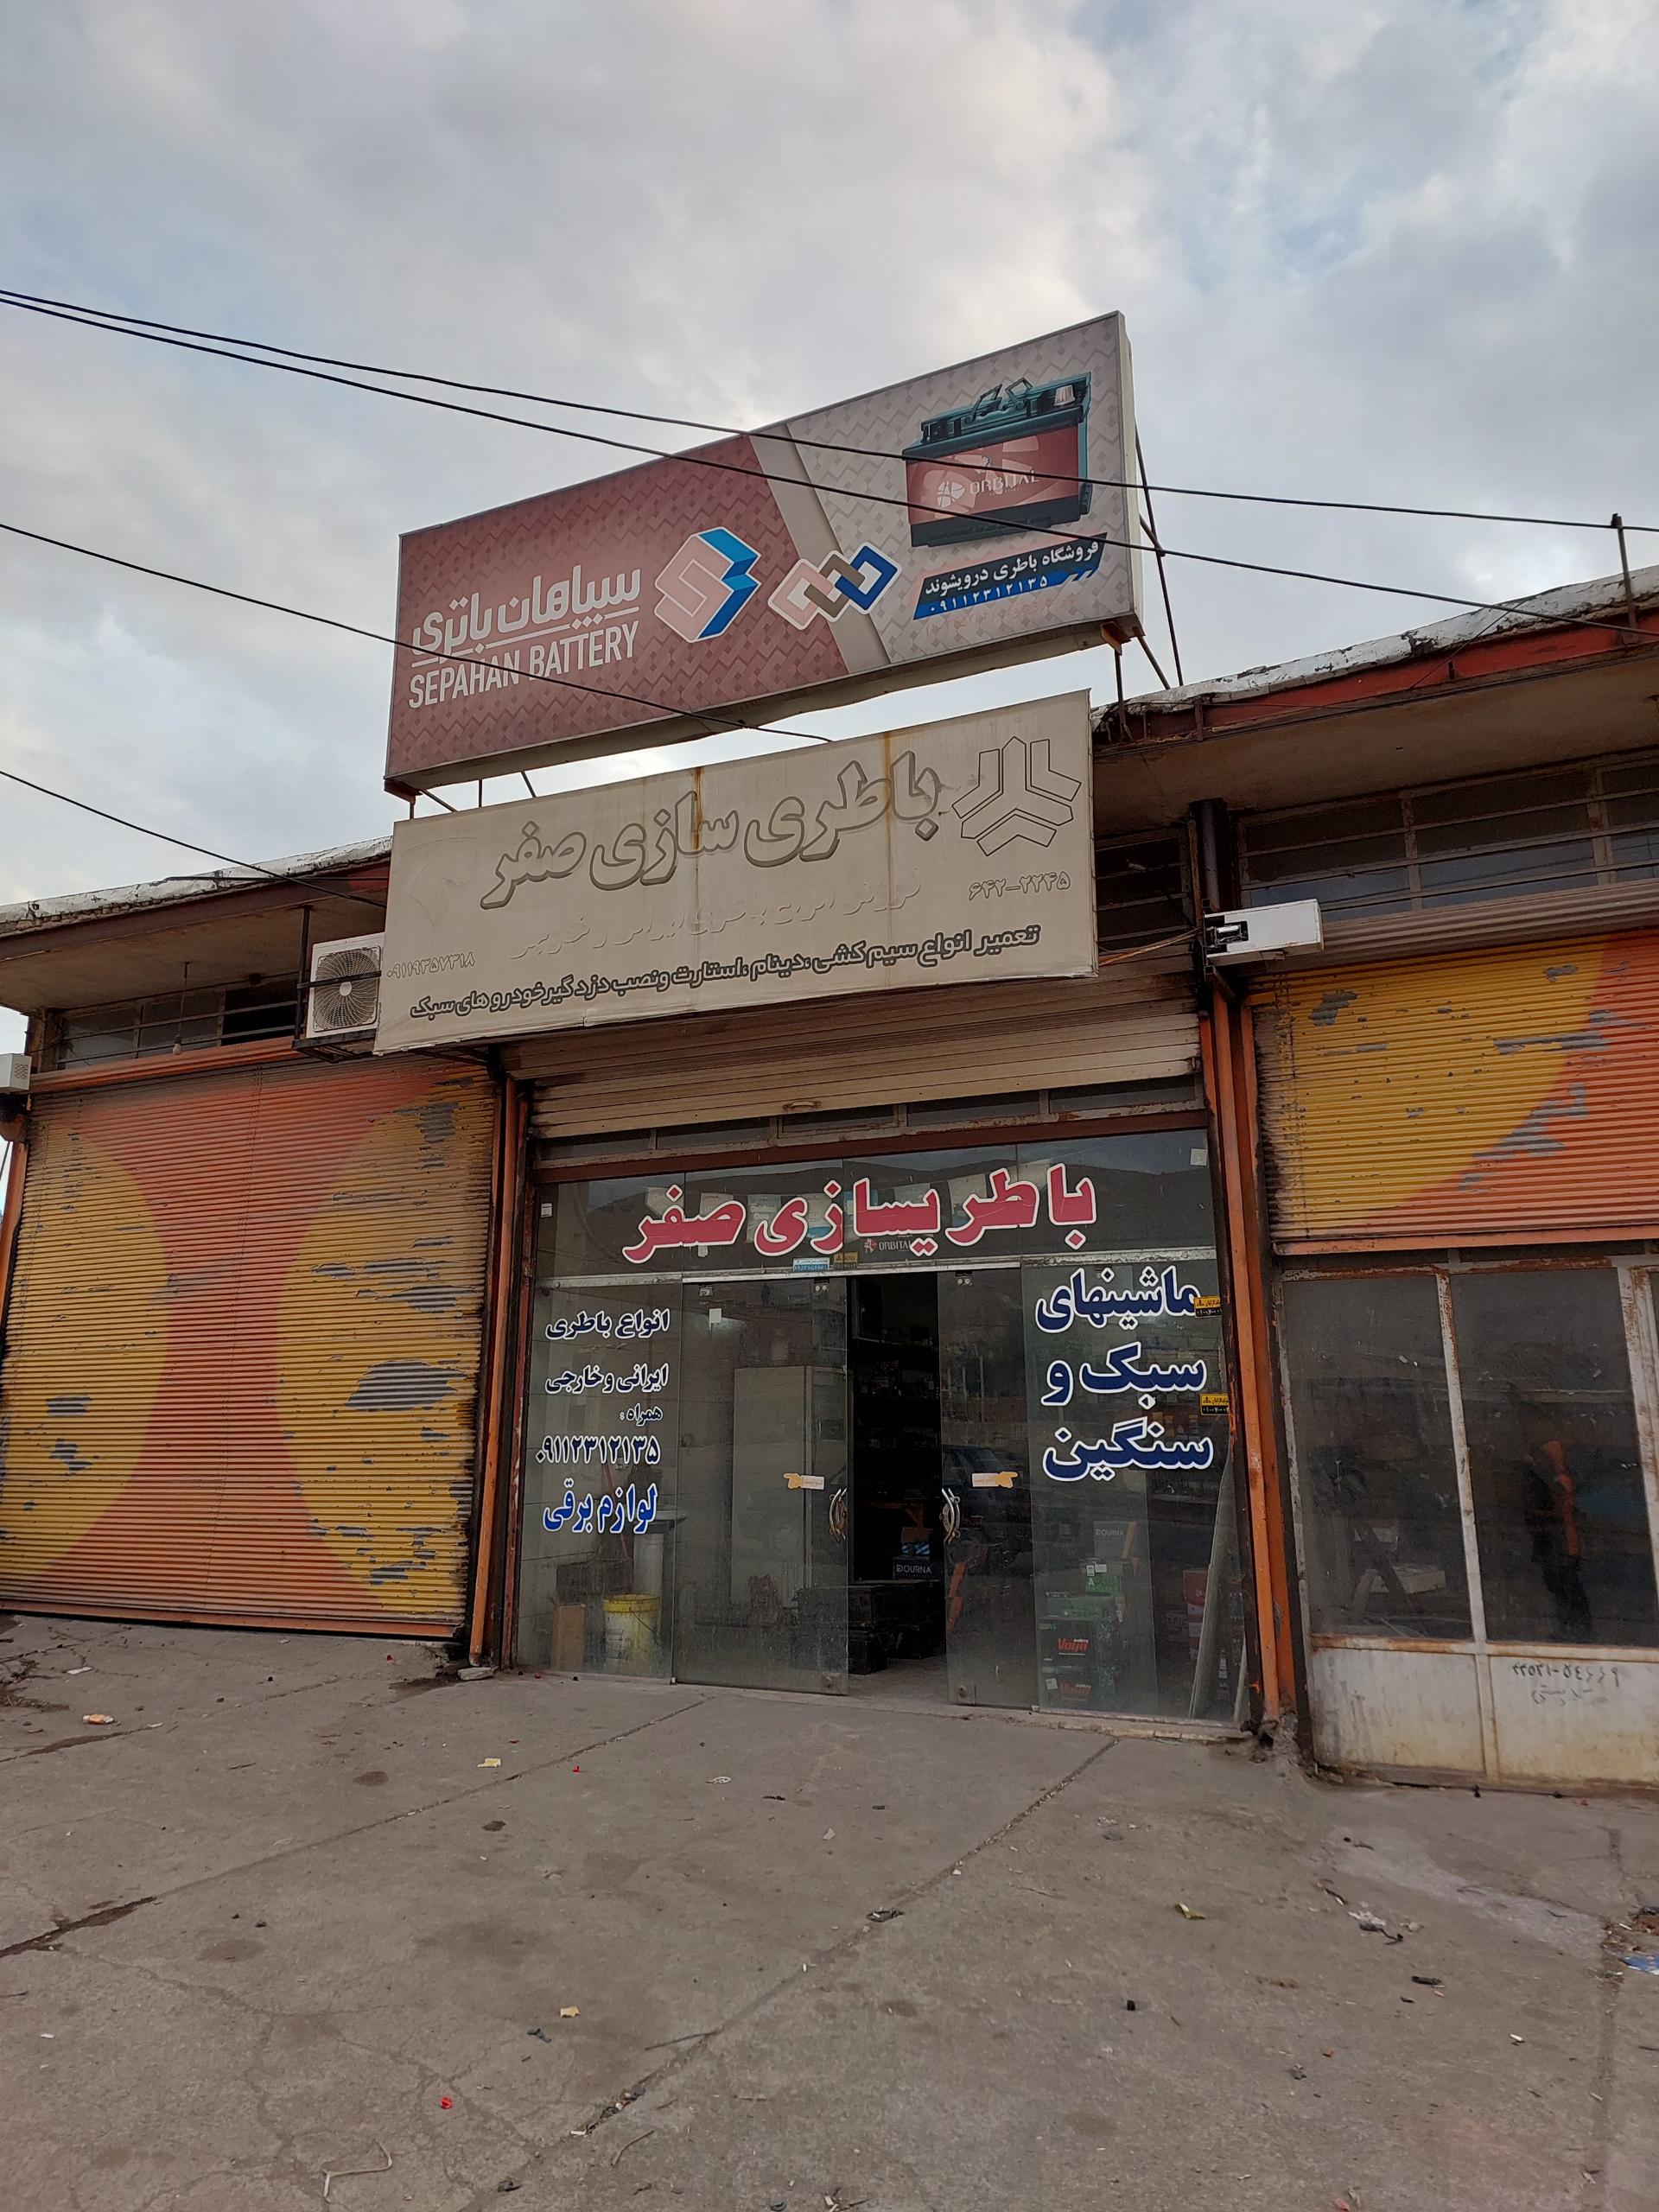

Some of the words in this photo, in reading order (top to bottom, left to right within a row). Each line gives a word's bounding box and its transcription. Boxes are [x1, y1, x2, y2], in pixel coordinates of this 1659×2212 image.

[993, 556, 1038, 582] باطری
[1042, 541, 1099, 567] فروشگاه
[497, 564, 641, 631] سپاهان
[925, 568, 989, 598] درویشوند
[930, 575, 1048, 612] ۰۹۱۱۲۳۱۲۱۳۵
[412, 592, 493, 664] باتری
[408, 649, 520, 709] SEPAHAN
[528, 620, 640, 681] BATTERY
[744, 750, 940, 868] باطری
[589, 790, 739, 892] سازی
[480, 820, 588, 911] صفر
[917, 929, 973, 967] انواع
[972, 924, 1041, 957] تعمیر
[410, 995, 456, 1021] سبک
[621, 1184, 746, 1263] صفر
[545, 1310, 612, 1340] باطری
[615, 1308, 671, 1338] انواع
[545, 1364, 604, 1395] خارجی
[616, 1363, 669, 1394] ایرانی
[1040, 1359, 1074, 1407] و
[1079, 1341, 1208, 1410] سبک
[536, 1434, 661, 1465] ۰۹۱۱۲۳۱۲۱۳۵
[1042, 1416, 1215, 1482] سنگین
[543, 1477, 594, 1534] برقی
[597, 1483, 658, 1534] لوازم
